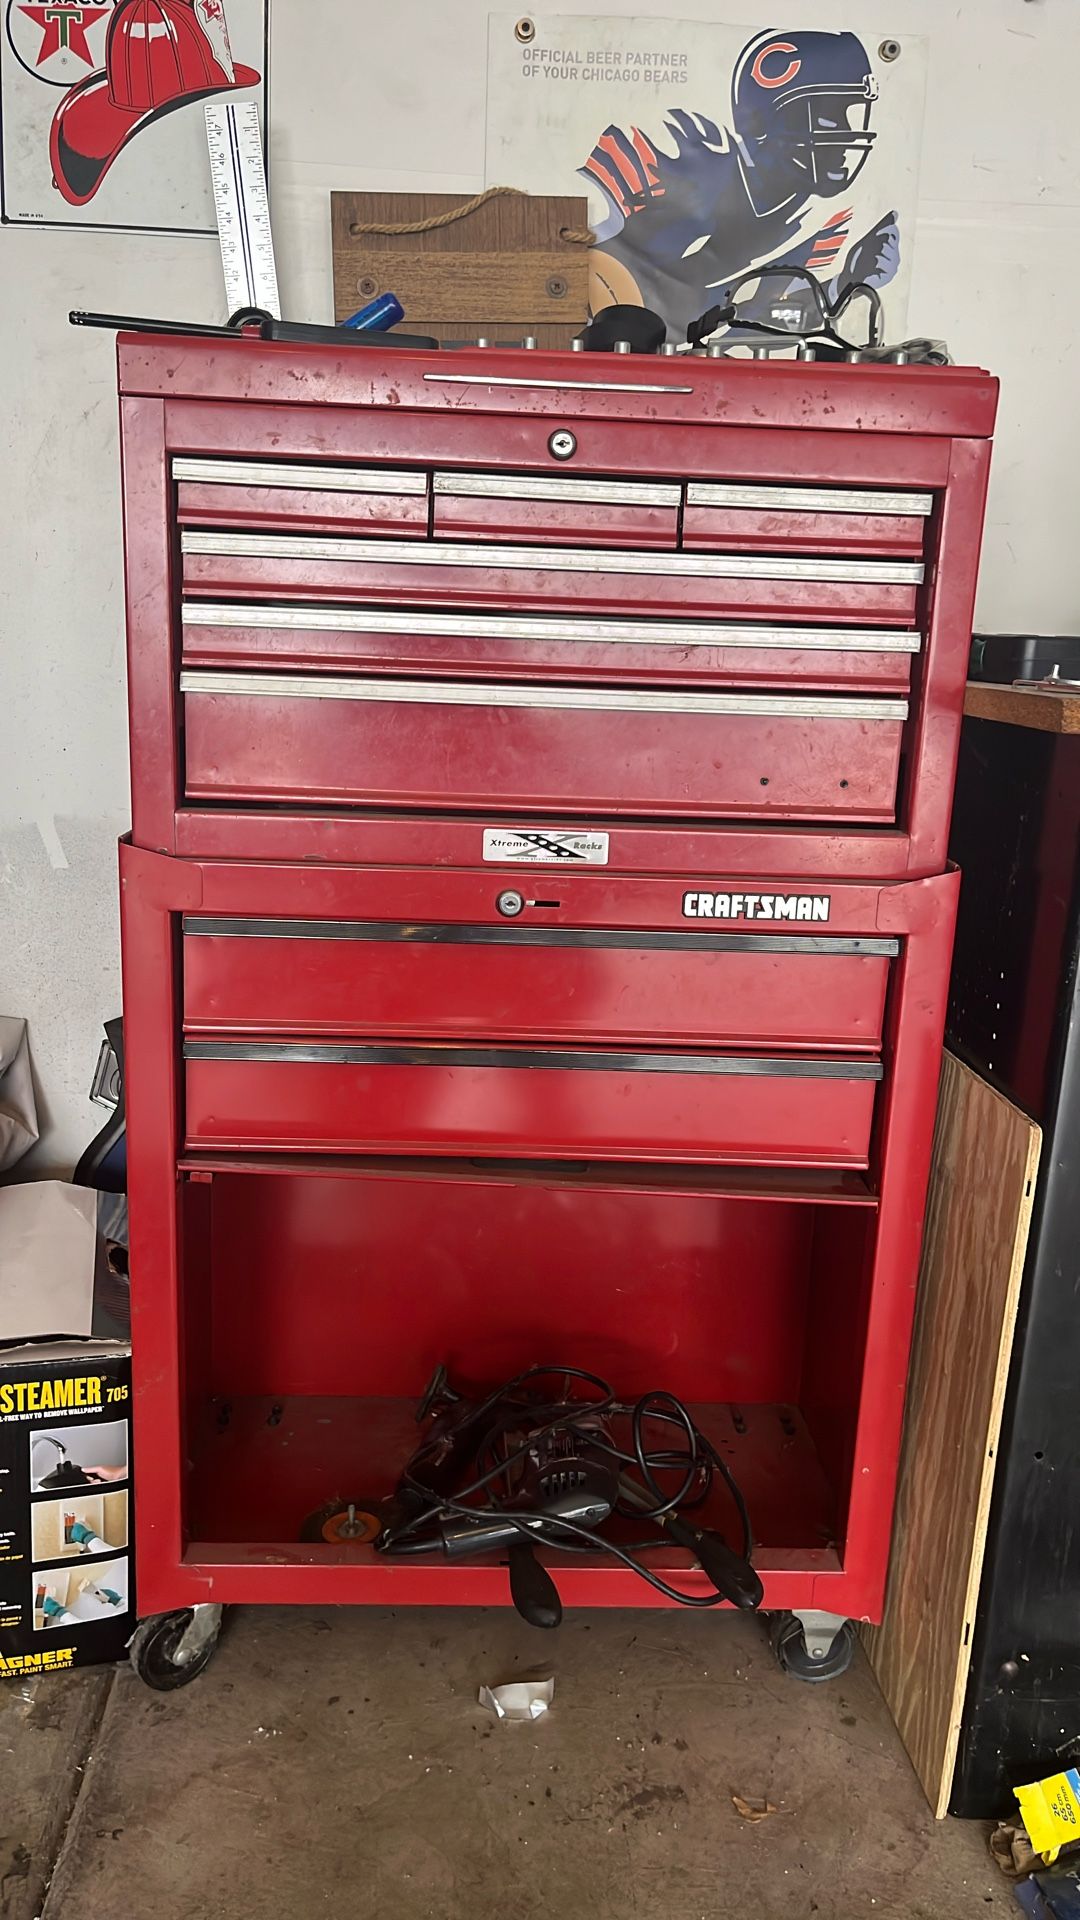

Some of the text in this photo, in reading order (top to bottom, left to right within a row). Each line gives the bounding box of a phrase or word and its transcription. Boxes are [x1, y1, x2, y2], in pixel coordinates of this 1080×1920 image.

[523, 48, 688, 67] OFFICIAL BEER PARTNER
[522, 64, 688, 84] OF YOUR CHICAGO BEARS
[215, 124, 222, 136] 47
[219, 152, 225, 166] 46
[490, 839, 603, 850] Xtreme Racks
[683, 892, 831, 922] CRAFTSMAN
[0, 1376, 129, 1413] STEAMER 705
[20, 1413, 34, 1421] WAY
[43, 1409, 68, 1418] REMOVE
[68, 1405, 104, 1416] WALLPAPER
[20, 1665, 43, 1675] PAINT
[45, 1660, 74, 1671] SMART.
[1061, 1785, 1069, 1802] mm
[1051, 1803, 1061, 1817] 26
[1056, 1793, 1069, 1821] 65 cm
[1066, 1803, 1077, 1824] 650
